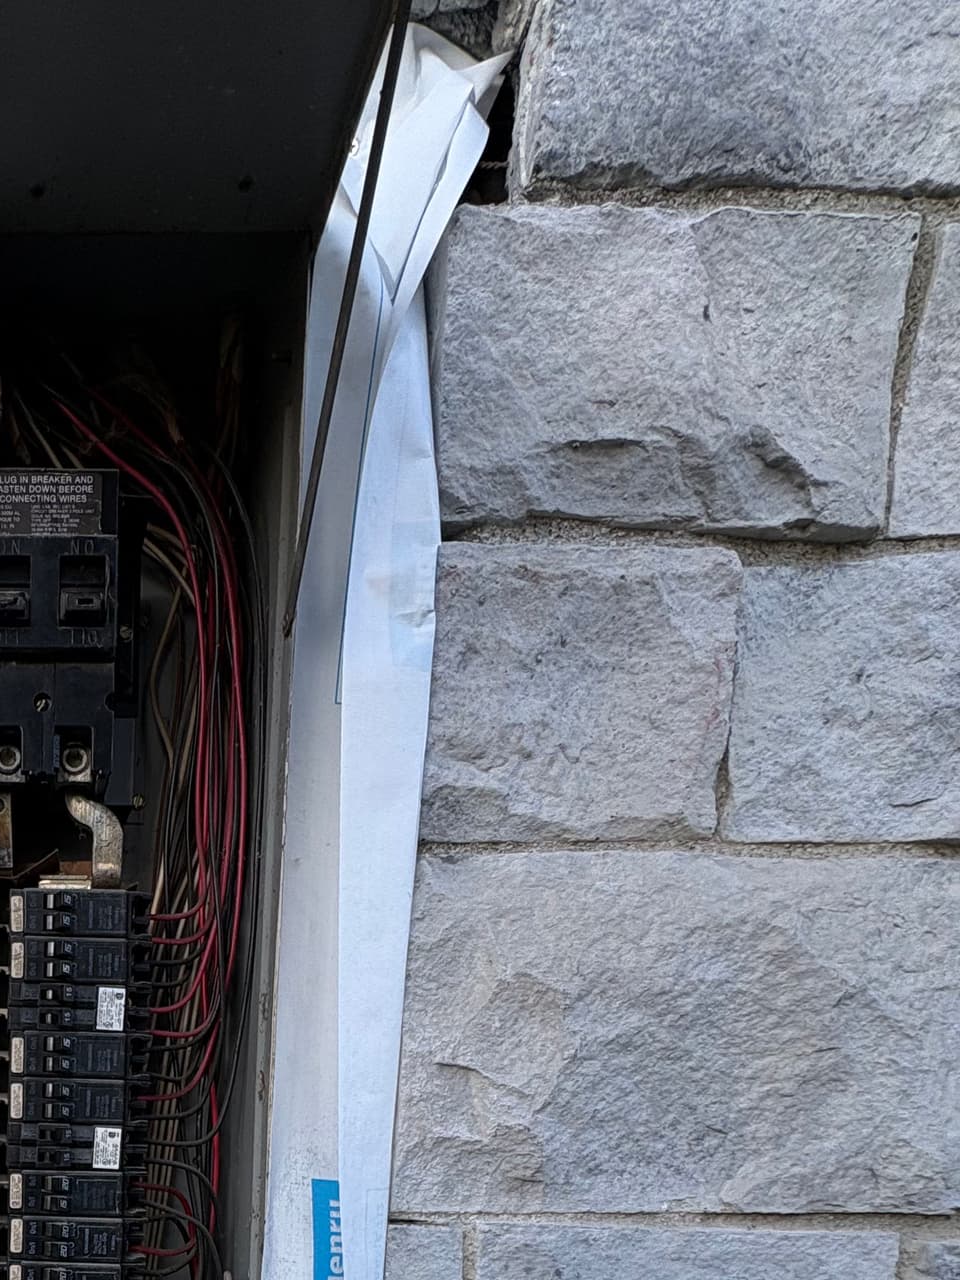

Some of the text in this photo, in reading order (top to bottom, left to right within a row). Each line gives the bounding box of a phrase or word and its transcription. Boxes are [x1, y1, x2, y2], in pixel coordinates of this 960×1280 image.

[20, 475, 29, 484] IN
[31, 475, 73, 484] BREAKER
[74, 475, 94, 484] AND
[29, 485, 56, 494] DOWN
[58, 485, 94, 494] BEFORE
[0, 494, 87, 503] CONNECTING WIRES
